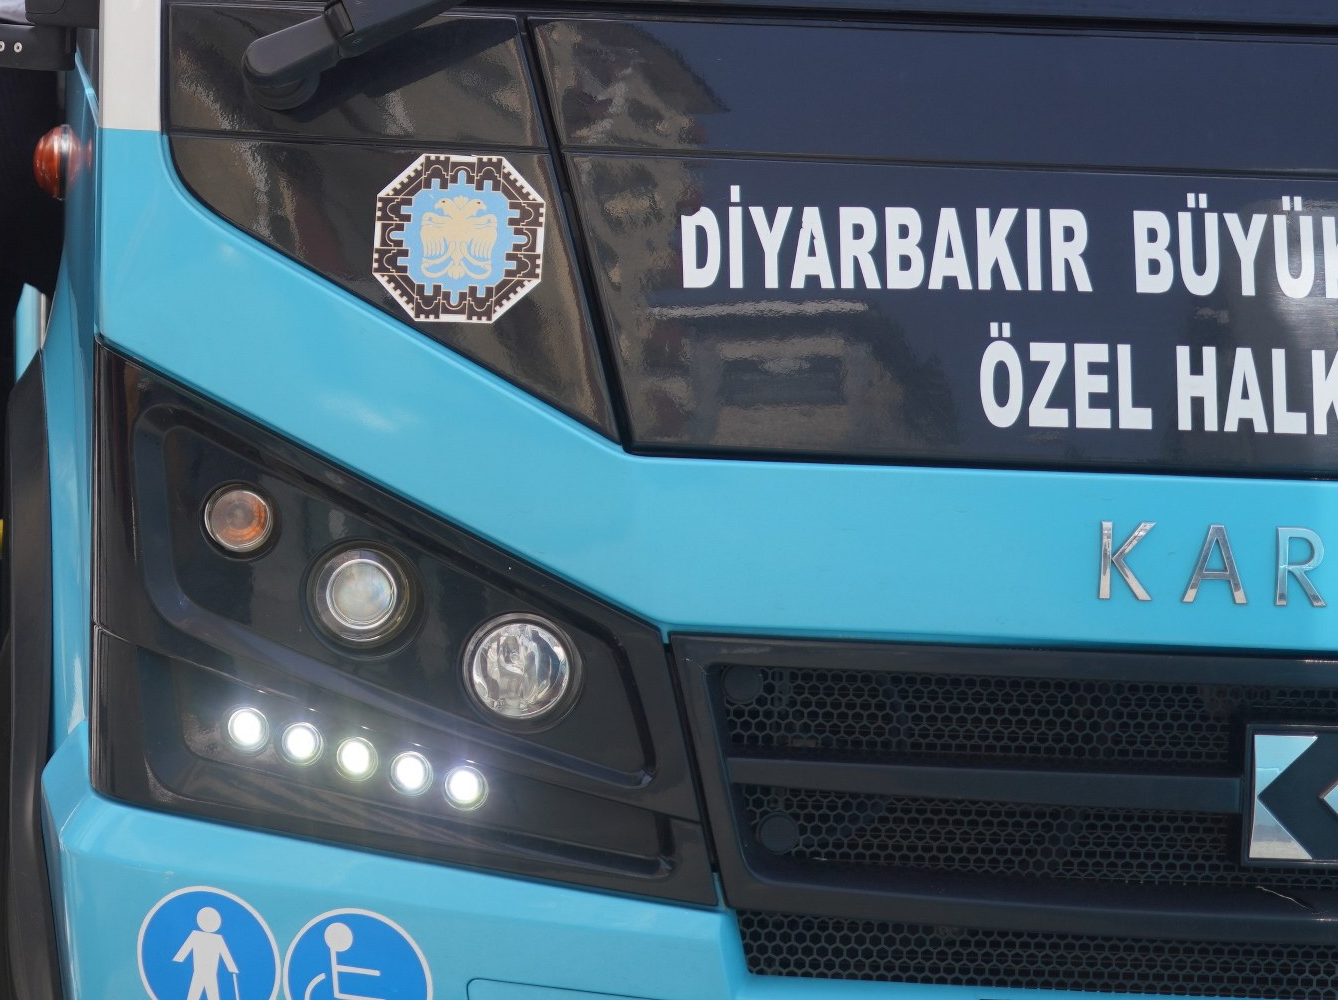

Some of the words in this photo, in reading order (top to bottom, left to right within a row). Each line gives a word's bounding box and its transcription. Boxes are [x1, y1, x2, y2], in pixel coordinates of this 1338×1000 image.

[680, 185, 1093, 293] DİYARBAKIR
[979, 322, 1153, 430] ÖZEL
[1098, 520, 1327, 608] KAR
